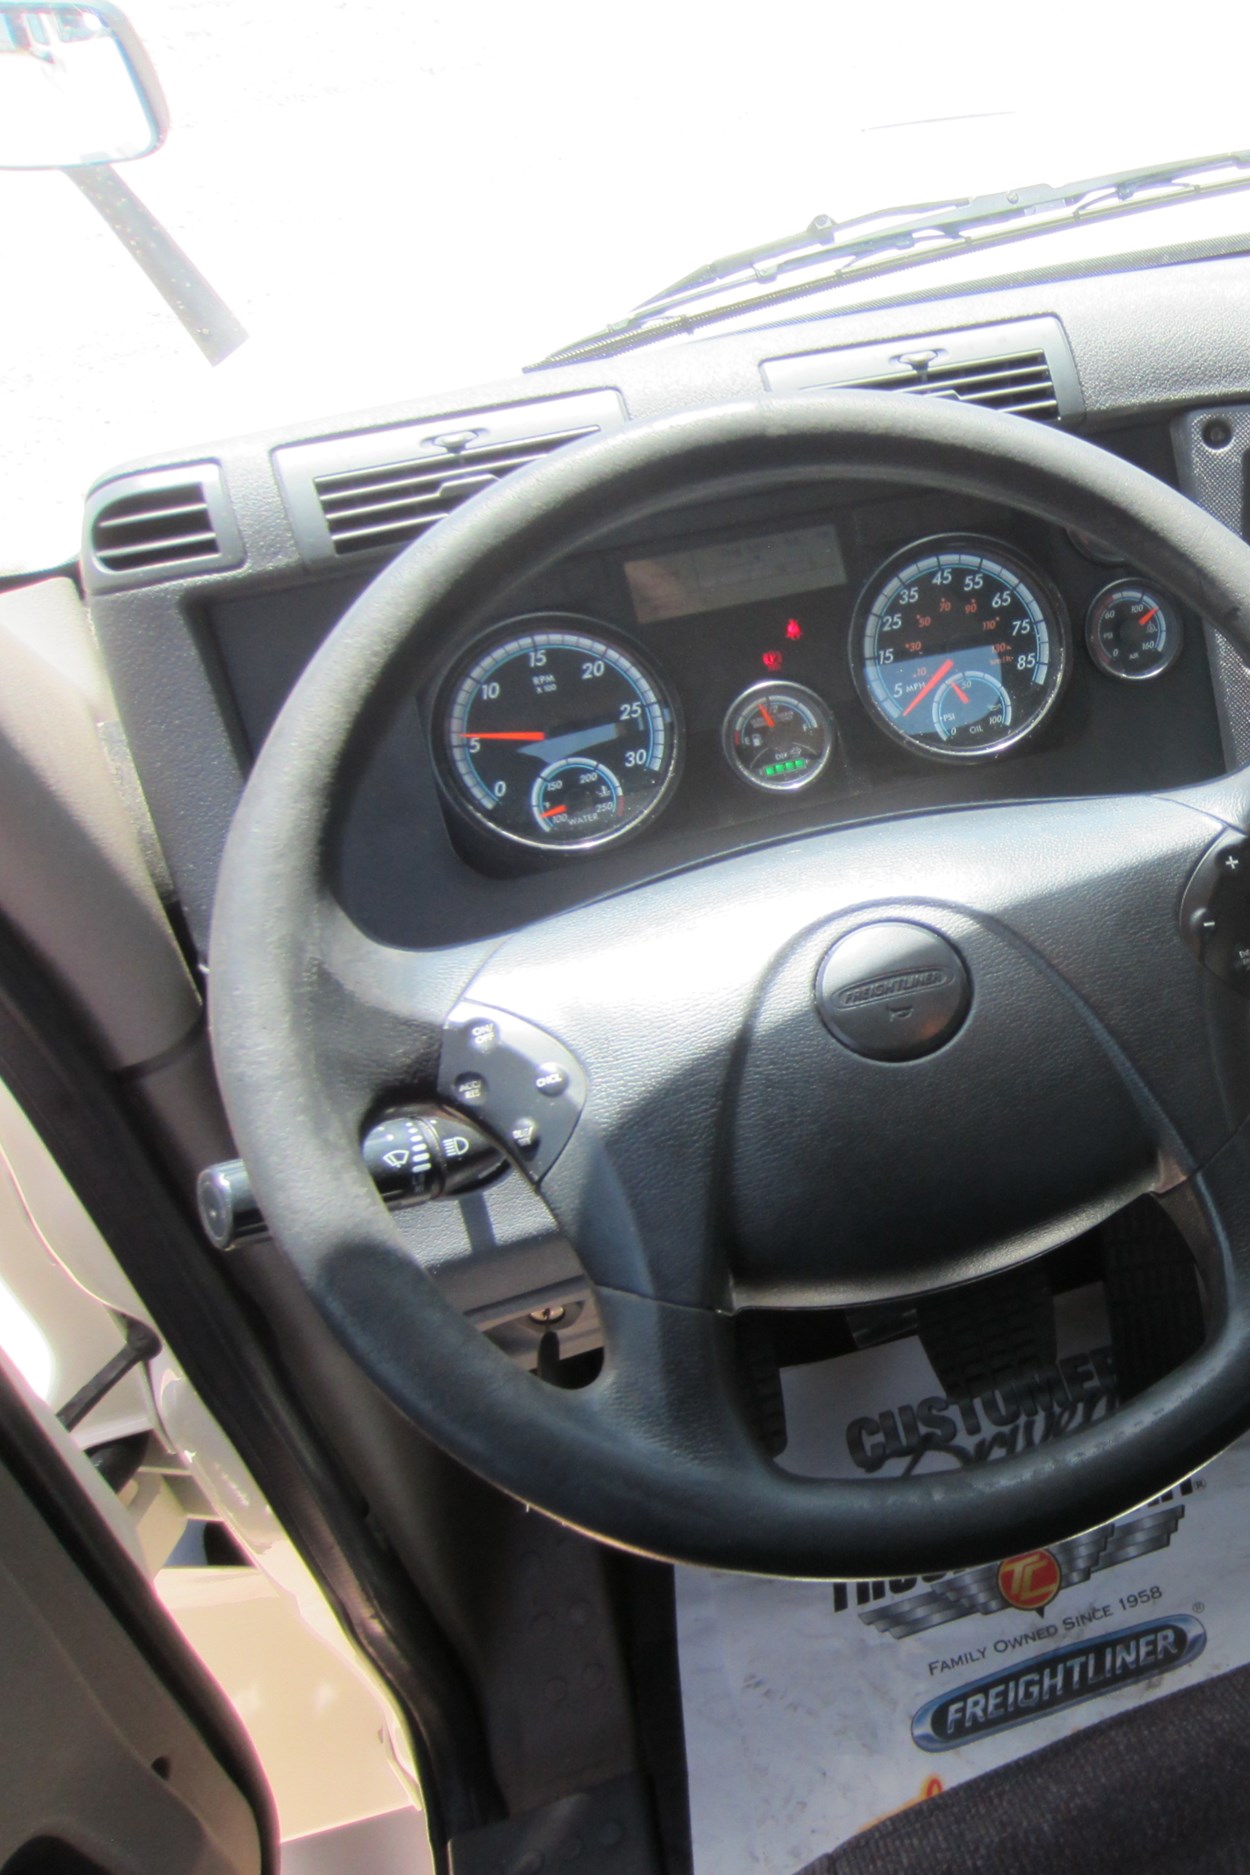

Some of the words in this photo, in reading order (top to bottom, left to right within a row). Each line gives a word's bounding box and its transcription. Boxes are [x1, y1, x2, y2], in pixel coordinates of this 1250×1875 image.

[932, 569, 952, 585] 45
[963, 573, 984, 591] 55
[900, 588, 919, 604] 35
[992, 591, 1011, 608] 65
[939, 602, 951, 612] 70
[965, 603, 977, 613] 90
[1131, 604, 1144, 613] 100
[1105, 610, 1115, 619] 60
[882, 614, 902, 631] 25
[918, 617, 932, 628] 50
[982, 620, 996, 630] 110
[1011, 619, 1031, 636] 75
[909, 641, 922, 651] 30
[1142, 641, 1155, 650] 160
[529, 650, 546, 667] 15
[878, 648, 894, 664] 15
[1113, 649, 1119, 657] 0
[1017, 653, 1036, 670] 85
[582, 661, 604, 679] 20
[532, 674, 556, 685] RPM
[961, 681, 972, 690] 50
[482, 682, 500, 700] 10
[893, 682, 903, 699] 5
[905, 681, 926, 693] MPH
[620, 702, 641, 720] 25
[989, 715, 1003, 724] 100
[950, 727, 957, 736] 0
[969, 725, 984, 734] OIL
[469, 737, 480, 753] 5
[624, 749, 646, 768] 30
[579, 772, 597, 784] 200
[494, 780, 506, 797] 0
[547, 780, 562, 791] 150
[595, 801, 614, 812] 250
[552, 813, 568, 824] 100
[568, 813, 598, 826] WATER
[844, 971, 943, 1005] FREIGHTLINER
[475, 1032, 495, 1044] OFF
[1002, 1552, 1054, 1602] TC
[927, 1646, 989, 1678] FAMILY
[992, 1623, 1060, 1655] OWNED
[1061, 1604, 1115, 1633] SINCE
[1117, 1584, 1164, 1612] 1958
[945, 1627, 1179, 1735] FREIGHTLINER
